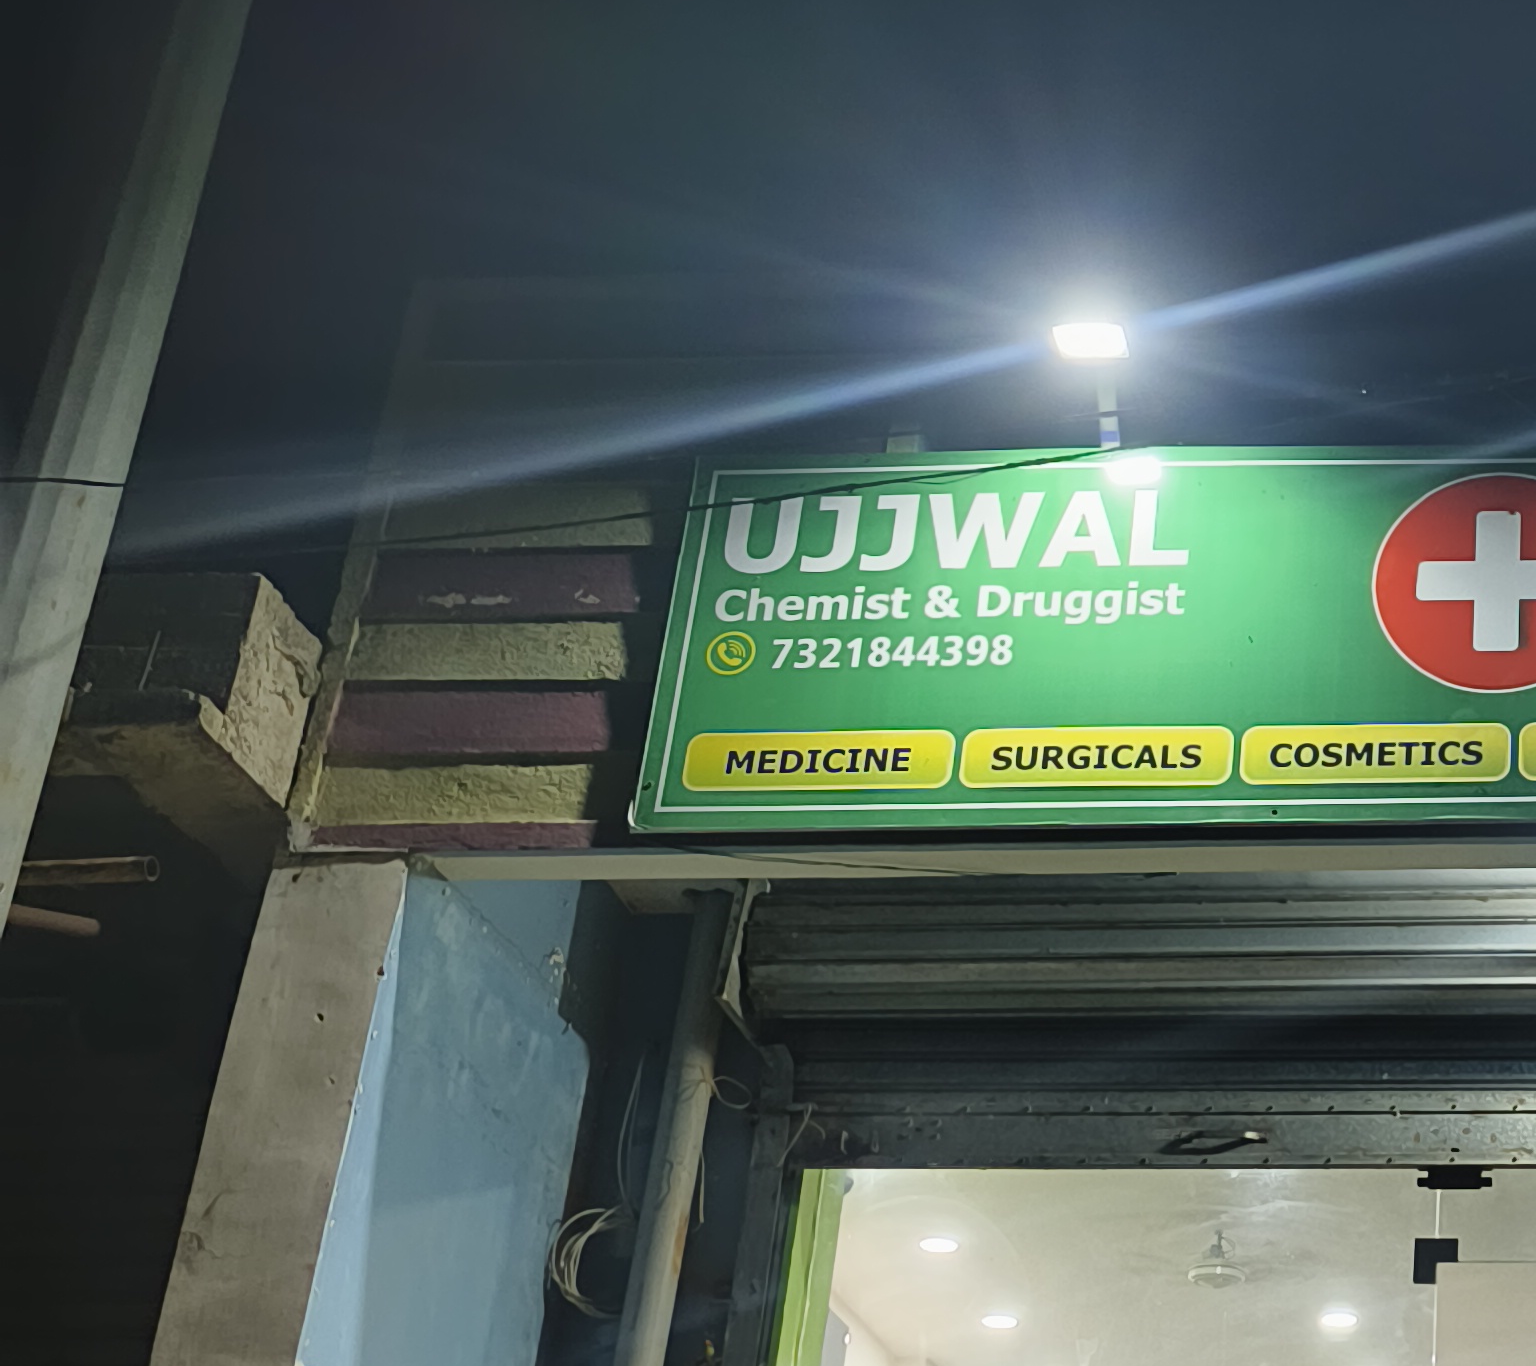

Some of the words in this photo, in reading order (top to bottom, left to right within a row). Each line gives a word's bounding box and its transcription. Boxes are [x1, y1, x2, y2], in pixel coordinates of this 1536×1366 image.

[724, 489, 1190, 574] UJJWAL
[714, 585, 911, 622] Chemist
[923, 584, 962, 619] &
[977, 580, 1186, 625] Druggist
[771, 634, 1014, 669] 7321844398
[725, 747, 912, 775] MEDICINE
[990, 744, 1202, 773] SURGICALS
[1269, 741, 1484, 768] COSMETICS
